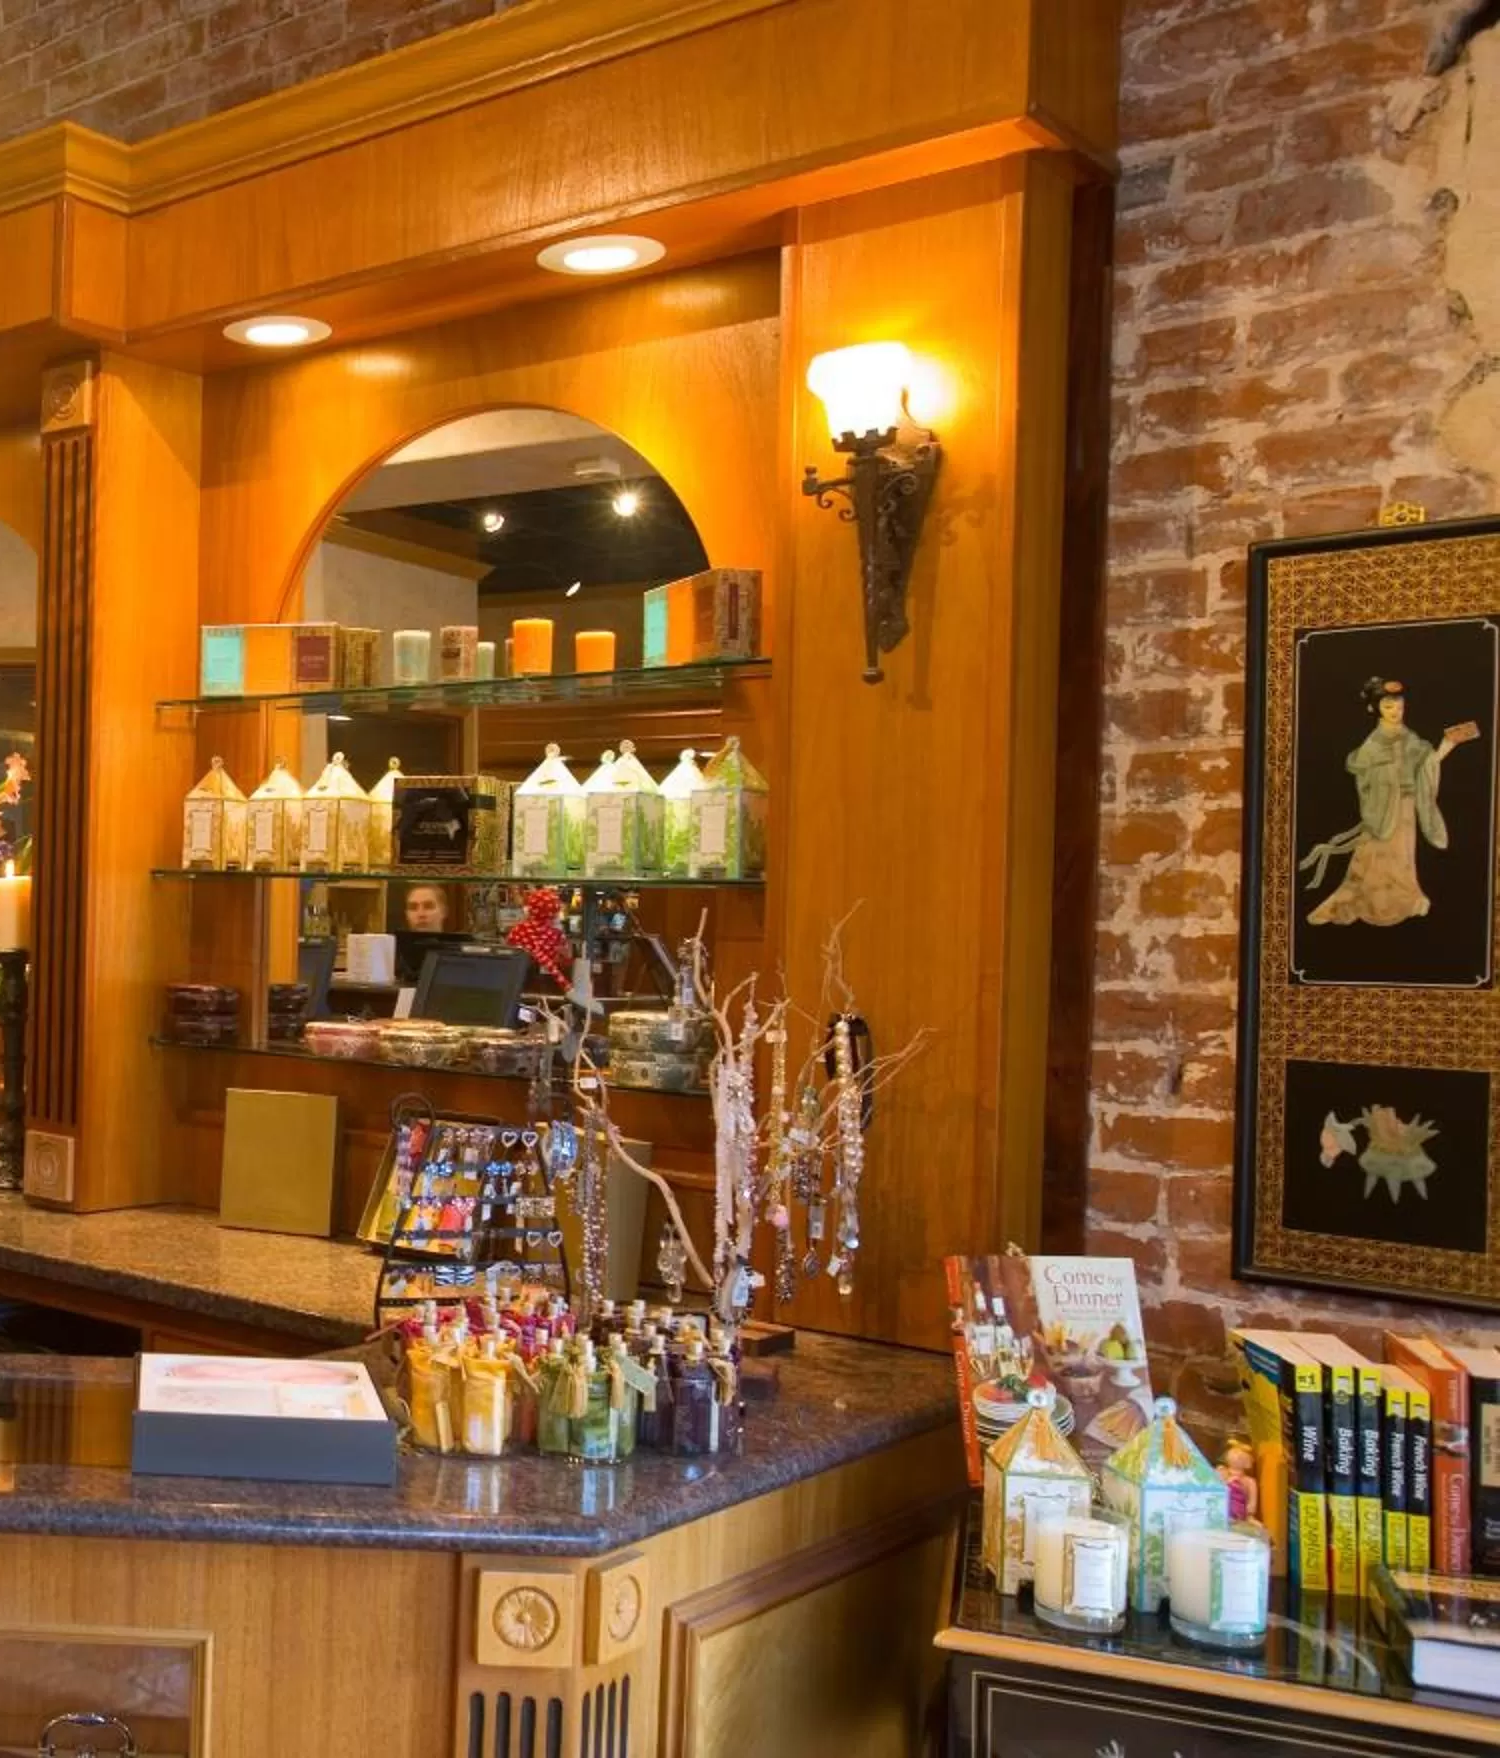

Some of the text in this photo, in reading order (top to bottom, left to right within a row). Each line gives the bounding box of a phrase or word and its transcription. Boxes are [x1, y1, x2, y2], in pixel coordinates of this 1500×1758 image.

[1043, 1264, 1105, 1285] Come
[1053, 1284, 1124, 1306] Dinner
[1302, 1425, 1319, 1462] Wine
[1334, 1427, 1354, 1476] Baking
[1360, 1429, 1380, 1477] Baking
[1390, 1431, 1405, 1497] French Wine
[1412, 1435, 1428, 1501] French Wine
[1449, 1472, 1465, 1512] Come
